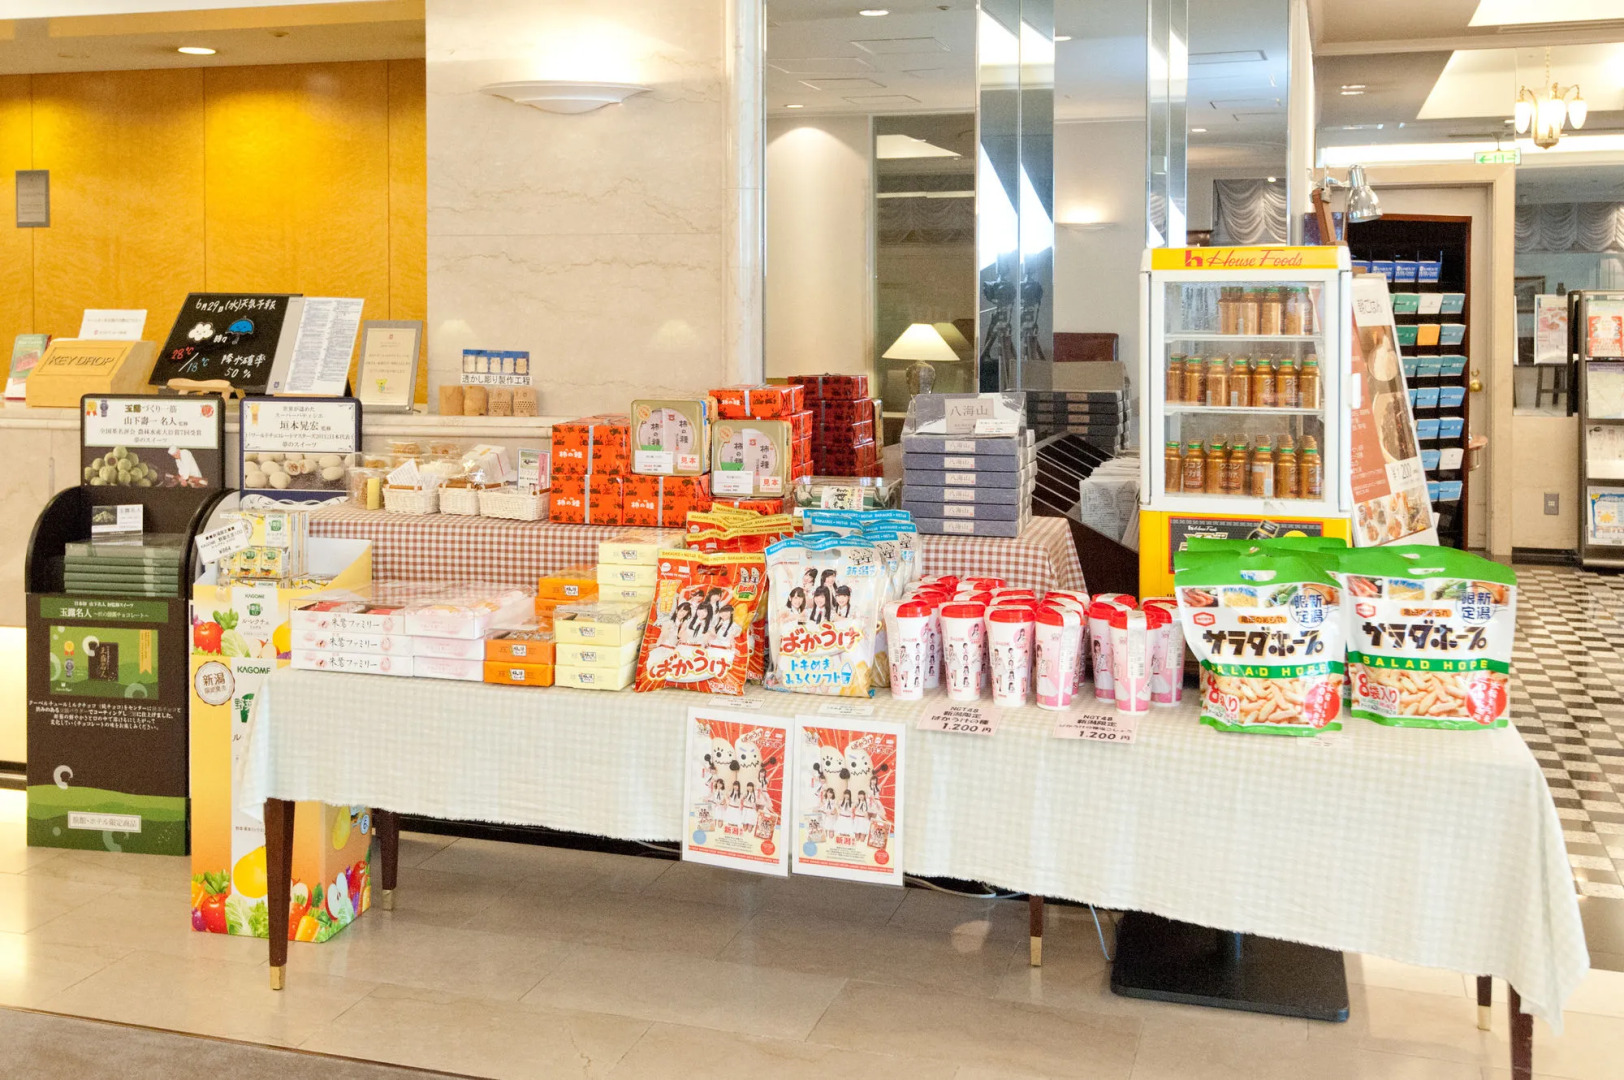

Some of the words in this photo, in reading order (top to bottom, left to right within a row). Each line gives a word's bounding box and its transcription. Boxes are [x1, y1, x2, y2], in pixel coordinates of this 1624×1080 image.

[1206, 250, 1255, 267] House
[1259, 249, 1303, 267] Foods
[48, 356, 78, 366] KEY
[77, 356, 115, 367] DROP
[221, 353, 266, 367] 降水確率
[224, 367, 239, 378] 50
[461, 374, 530, 385] 透かし彫り製作工程
[950, 405, 988, 416] 八海山
[558, 450, 583, 459] 柿の種
[680, 456, 697, 464] 見本
[762, 478, 779, 486] 見本
[556, 498, 580, 508] 柿の種
[630, 501, 655, 510] 柿の種
[1309, 594, 1324, 624] 新潟
[1461, 591, 1476, 620] 限定
[1476, 592, 1492, 620] 新潟
[780, 623, 860, 653] ばかうけ
[1202, 626, 1324, 656] サラダホープ
[1362, 619, 1487, 650] サラダホープ
[649, 649, 731, 678] ばかうけ
[791, 658, 830, 672] トキめき
[1281, 663, 1328, 676] HOPE
[1362, 655, 1430, 670] SALAD
[1443, 660, 1489, 670] HOPE
[203, 672, 226, 686] 新潟
[1358, 673, 1397, 704] 8袋入り
[931, 715, 989, 725] ばかうけの種
[1077, 719, 1117, 727] 新潟限定
[851, 735, 874, 750] ばかうけ
